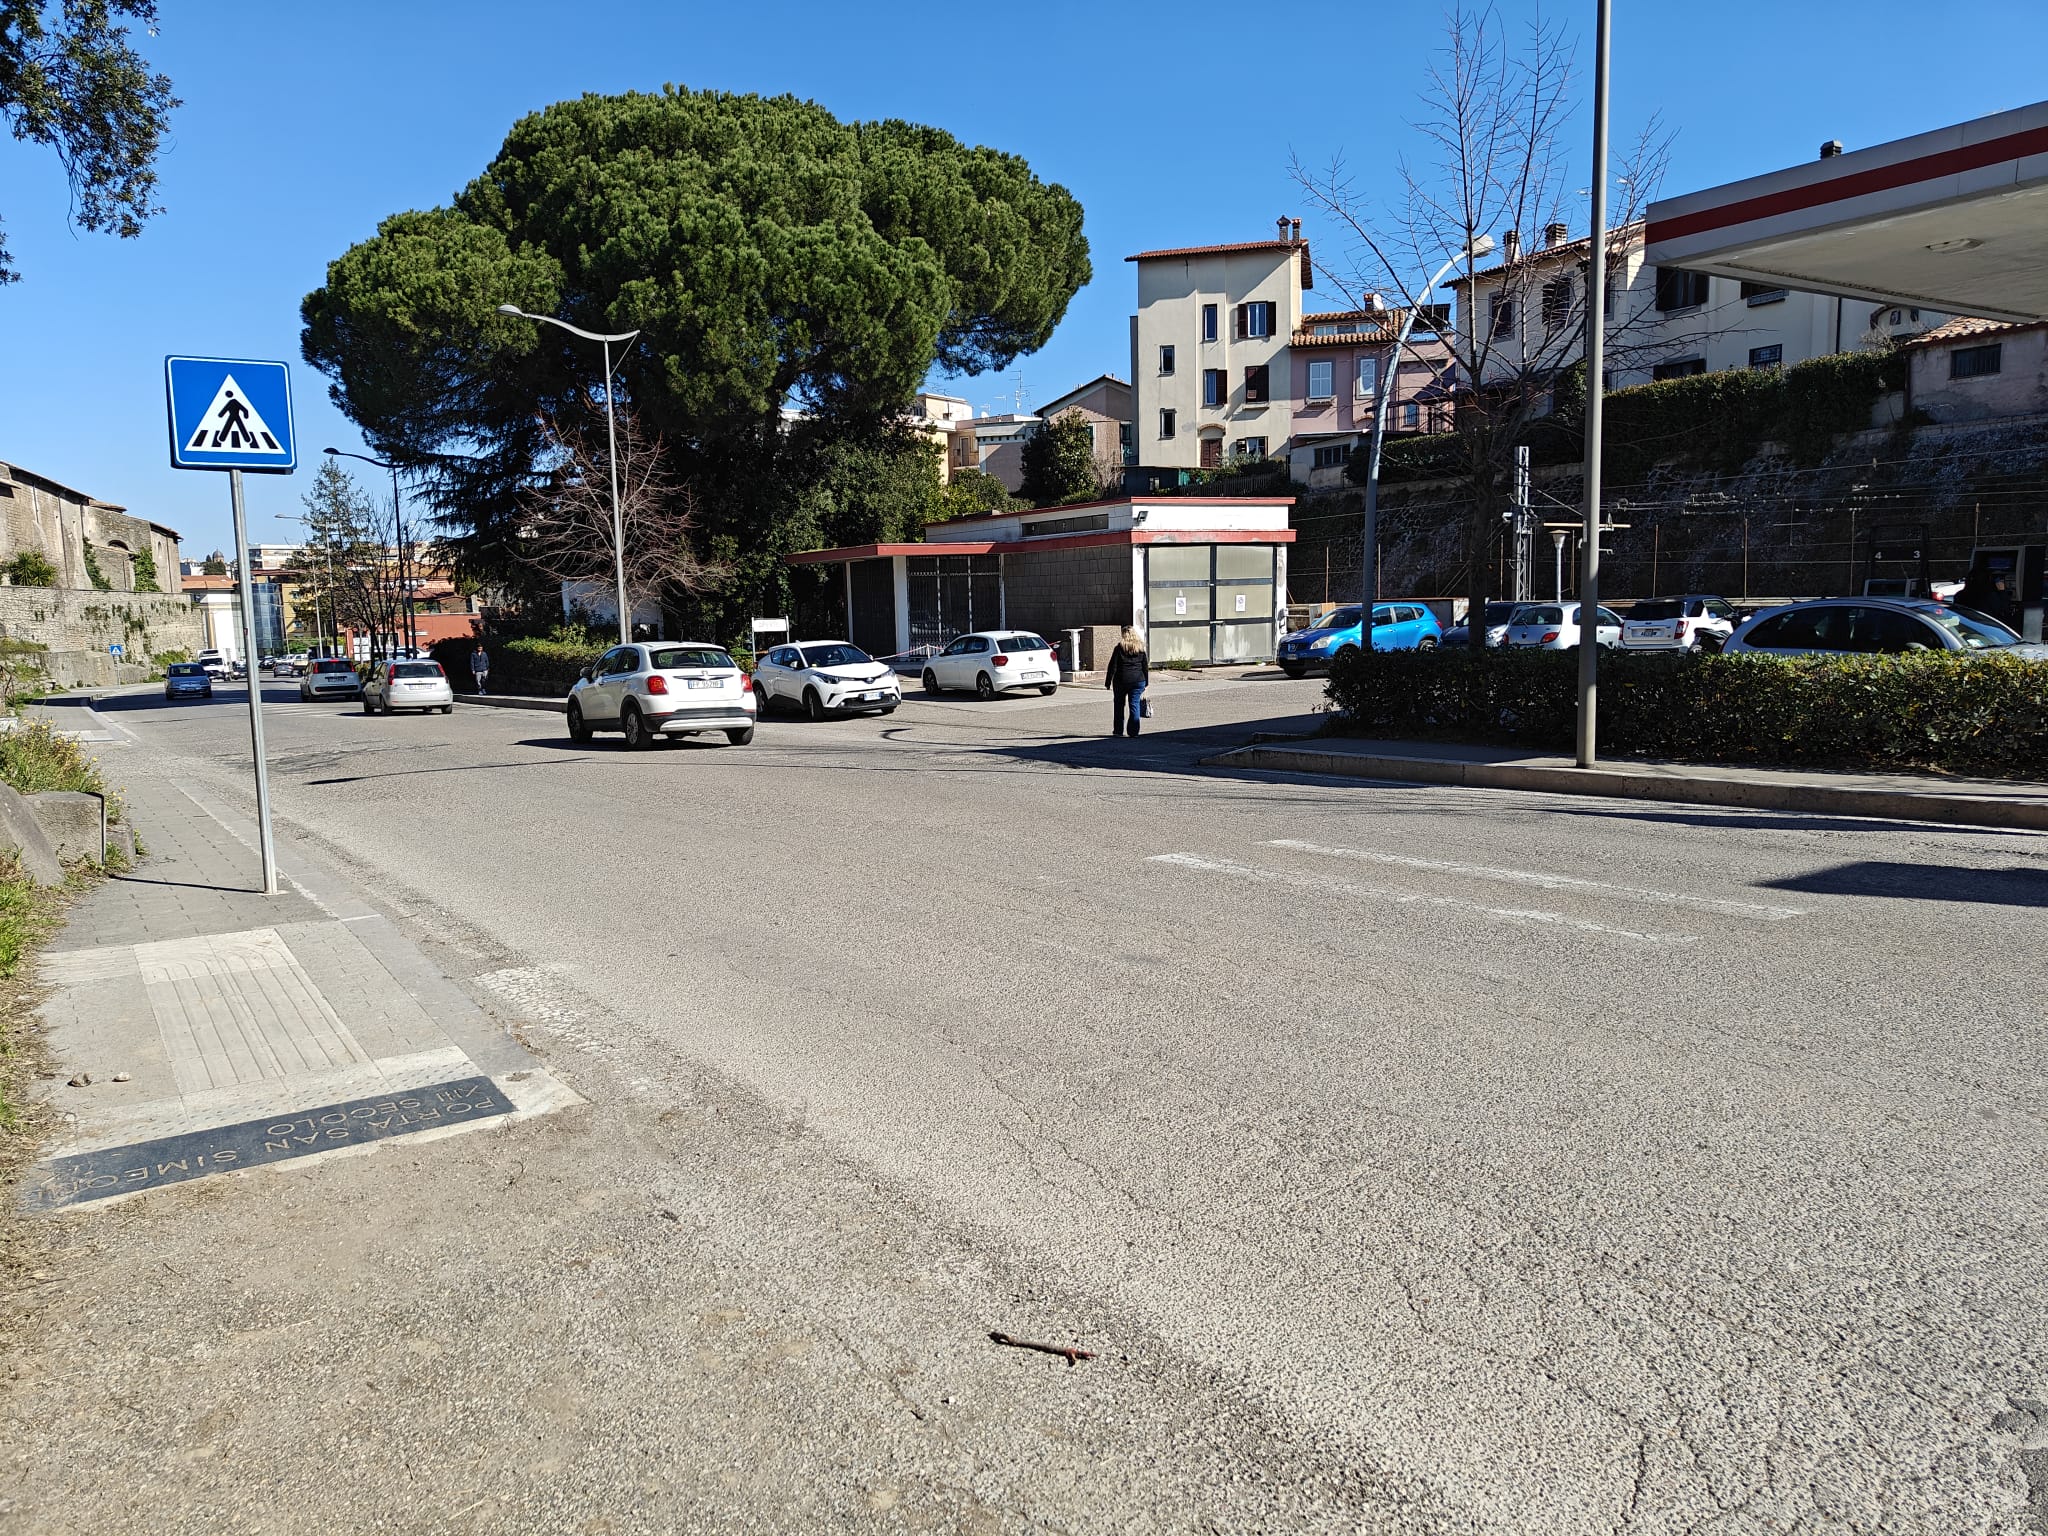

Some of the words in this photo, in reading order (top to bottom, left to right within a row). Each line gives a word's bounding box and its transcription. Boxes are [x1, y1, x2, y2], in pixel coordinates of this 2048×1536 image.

[1874, 551, 1882, 560] 4
[1913, 550, 1921, 559] 3
[266, 1098, 421, 1136] SECOLO
[368, 1097, 495, 1129] PORTA
[264, 1127, 349, 1152] SAN
